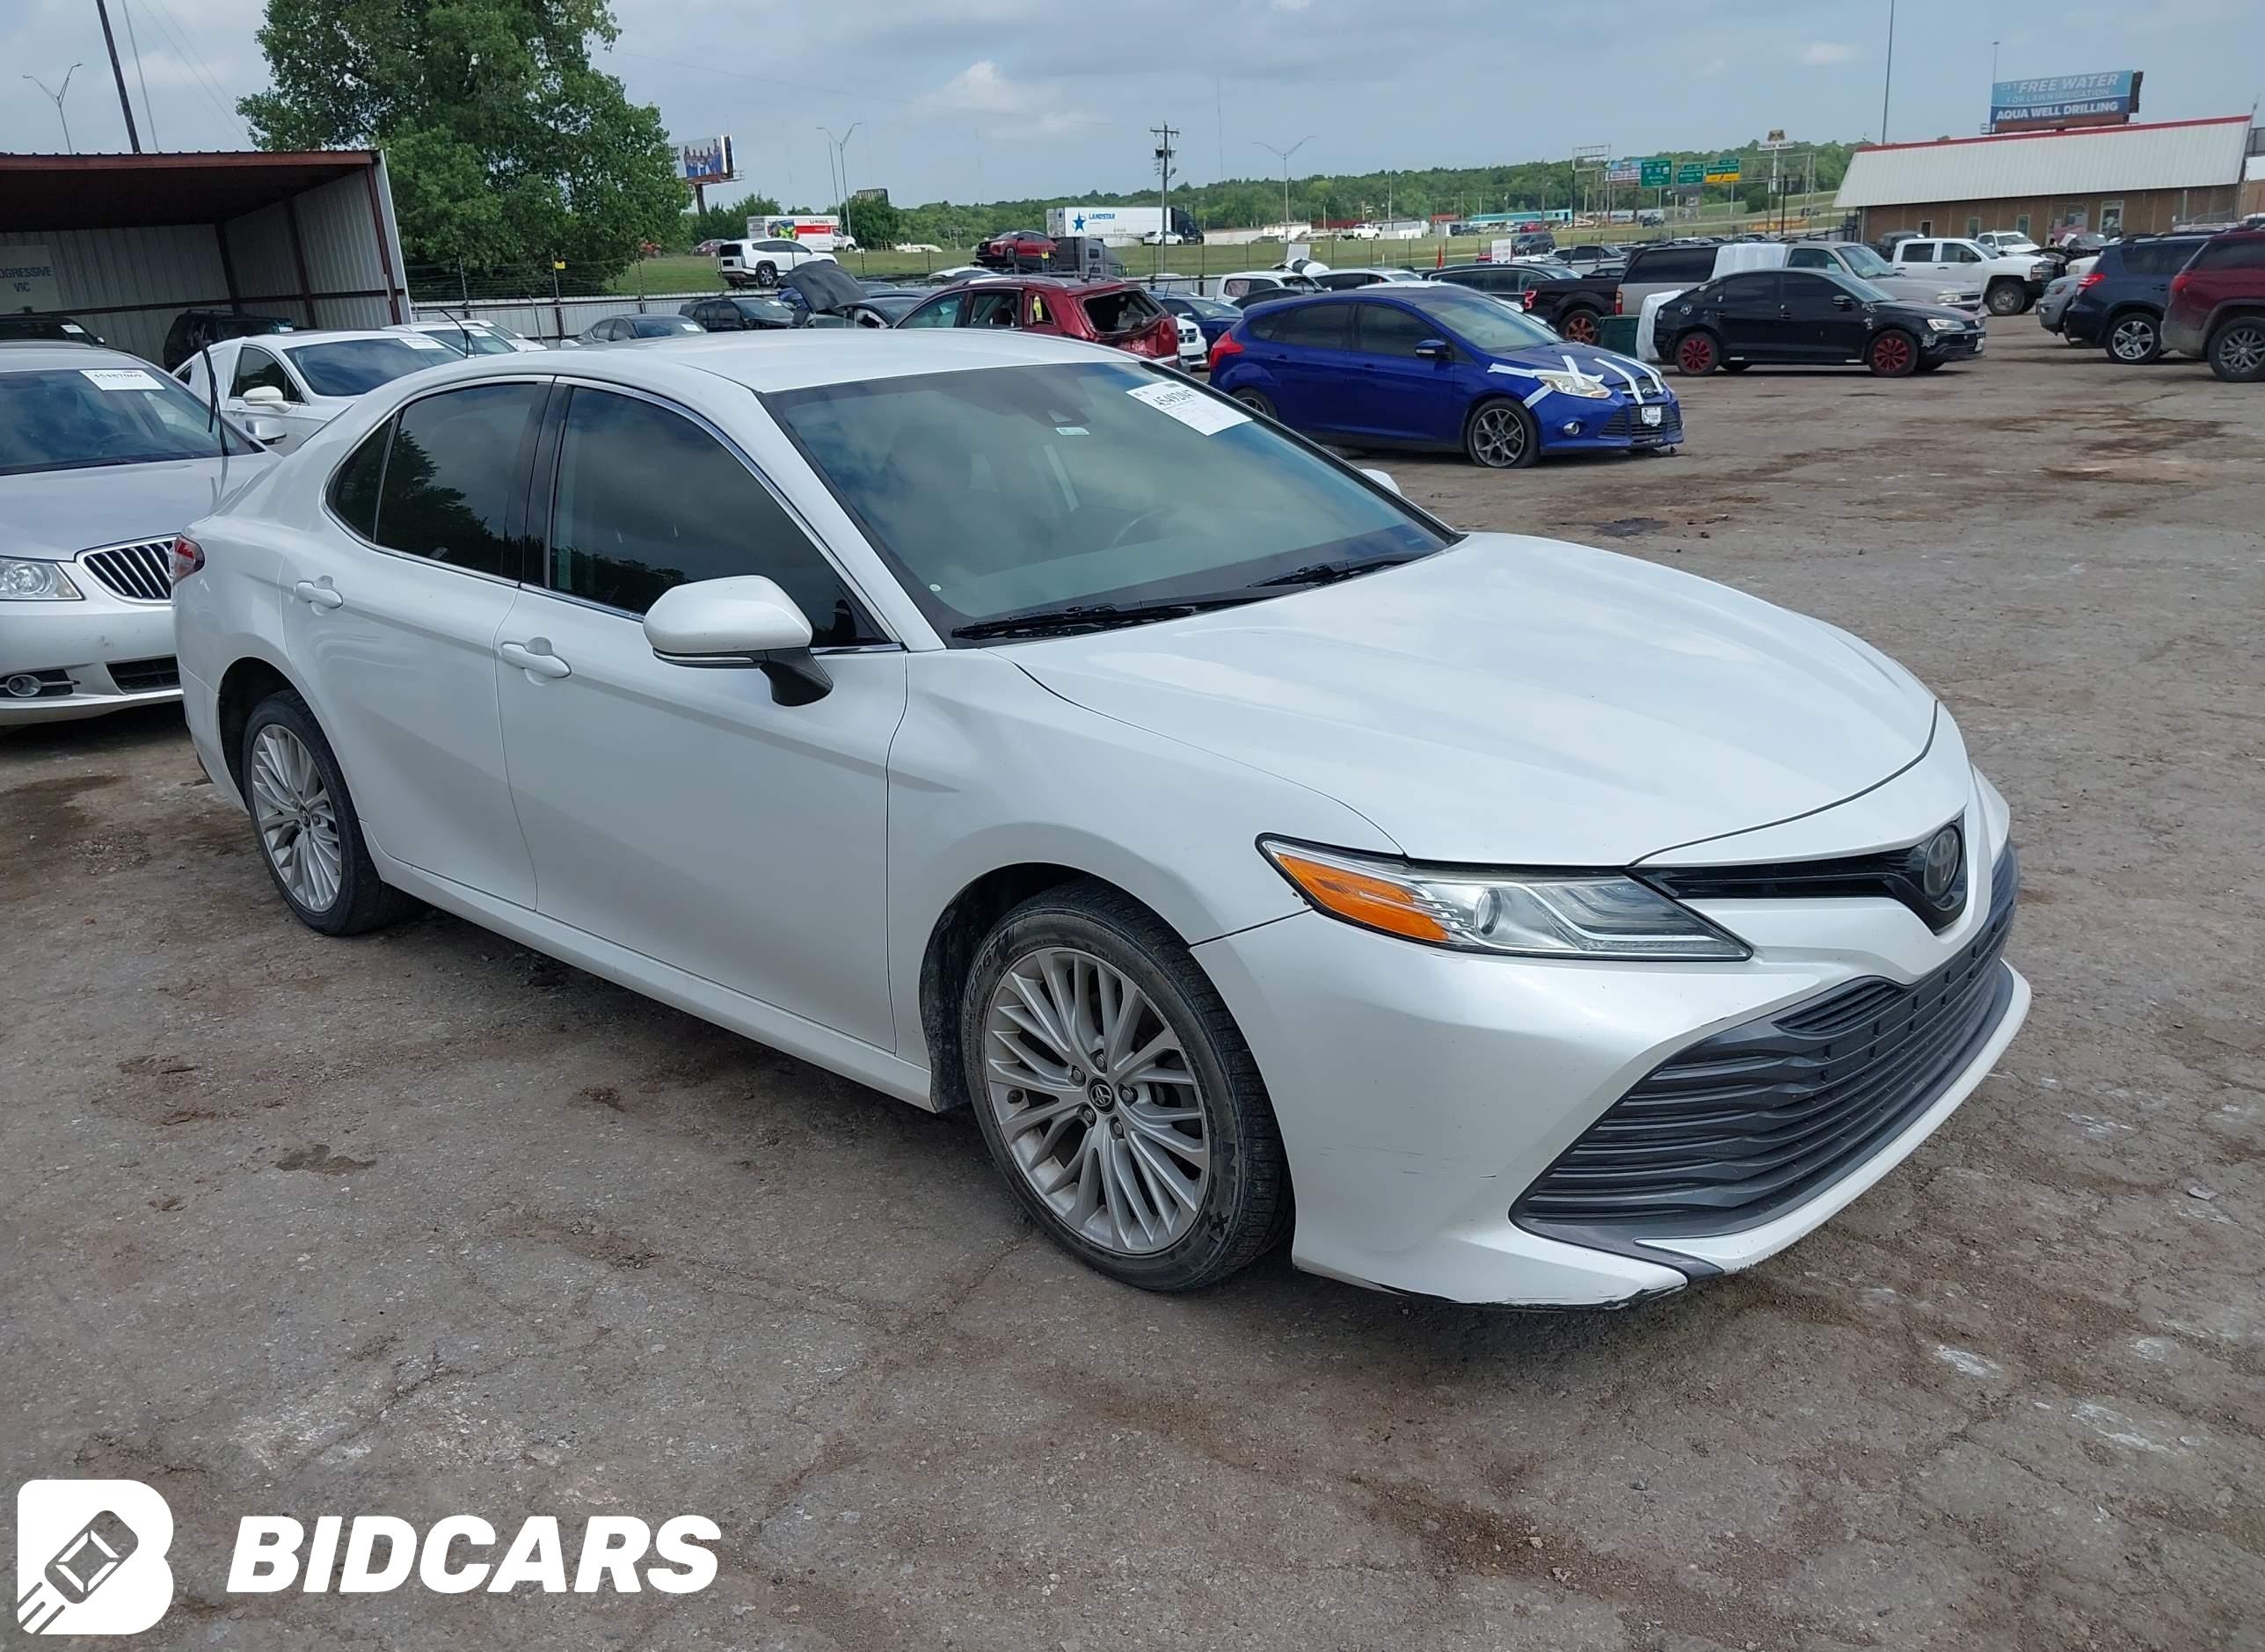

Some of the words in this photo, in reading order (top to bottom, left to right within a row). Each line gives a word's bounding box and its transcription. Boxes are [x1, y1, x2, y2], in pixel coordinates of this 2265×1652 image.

[2019, 79, 2057, 93] FREE
[2063, 73, 2118, 90] WATER
[2027, 93, 2053, 102] LAWN
[1996, 109, 2028, 120] AQUA
[2031, 106, 2062, 117] WELL
[2064, 101, 2118, 115] DRILLING
[14, 281, 31, 292] VIC
